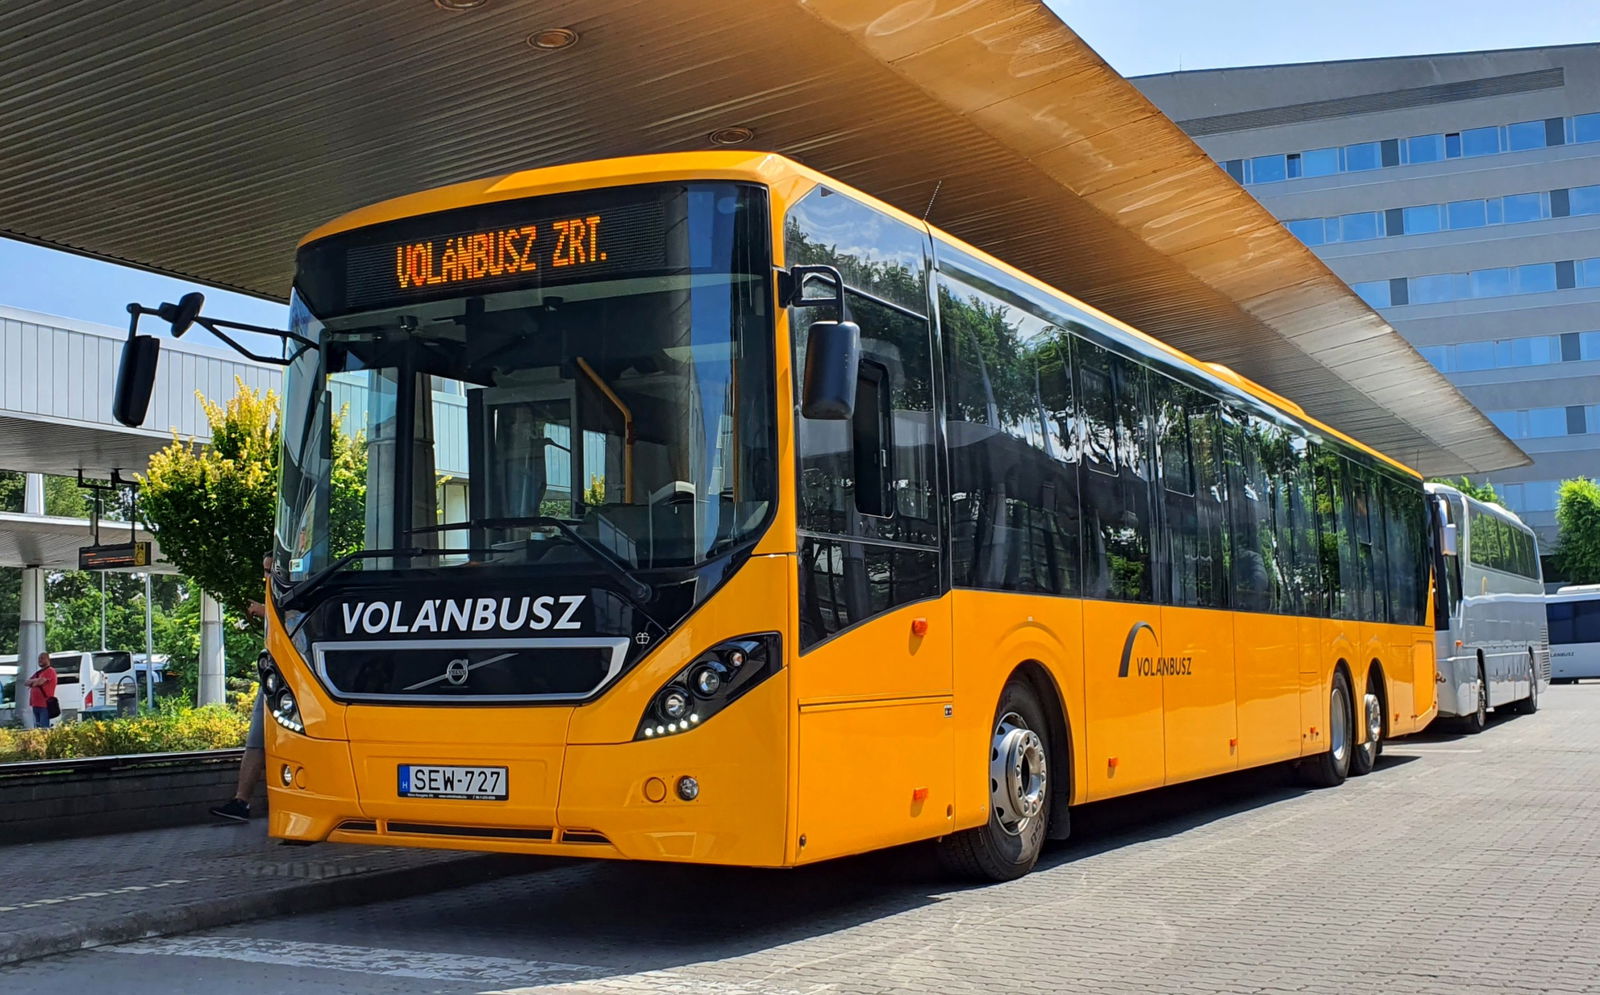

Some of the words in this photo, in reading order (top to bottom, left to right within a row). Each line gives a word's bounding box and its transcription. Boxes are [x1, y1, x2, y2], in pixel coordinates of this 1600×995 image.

[397, 226, 536, 288] VOLÁNBUSZ
[553, 216, 607, 267] ZRT.
[342, 595, 586, 634] VOLÁNBUSZ
[414, 769, 501, 792] SEW-727
